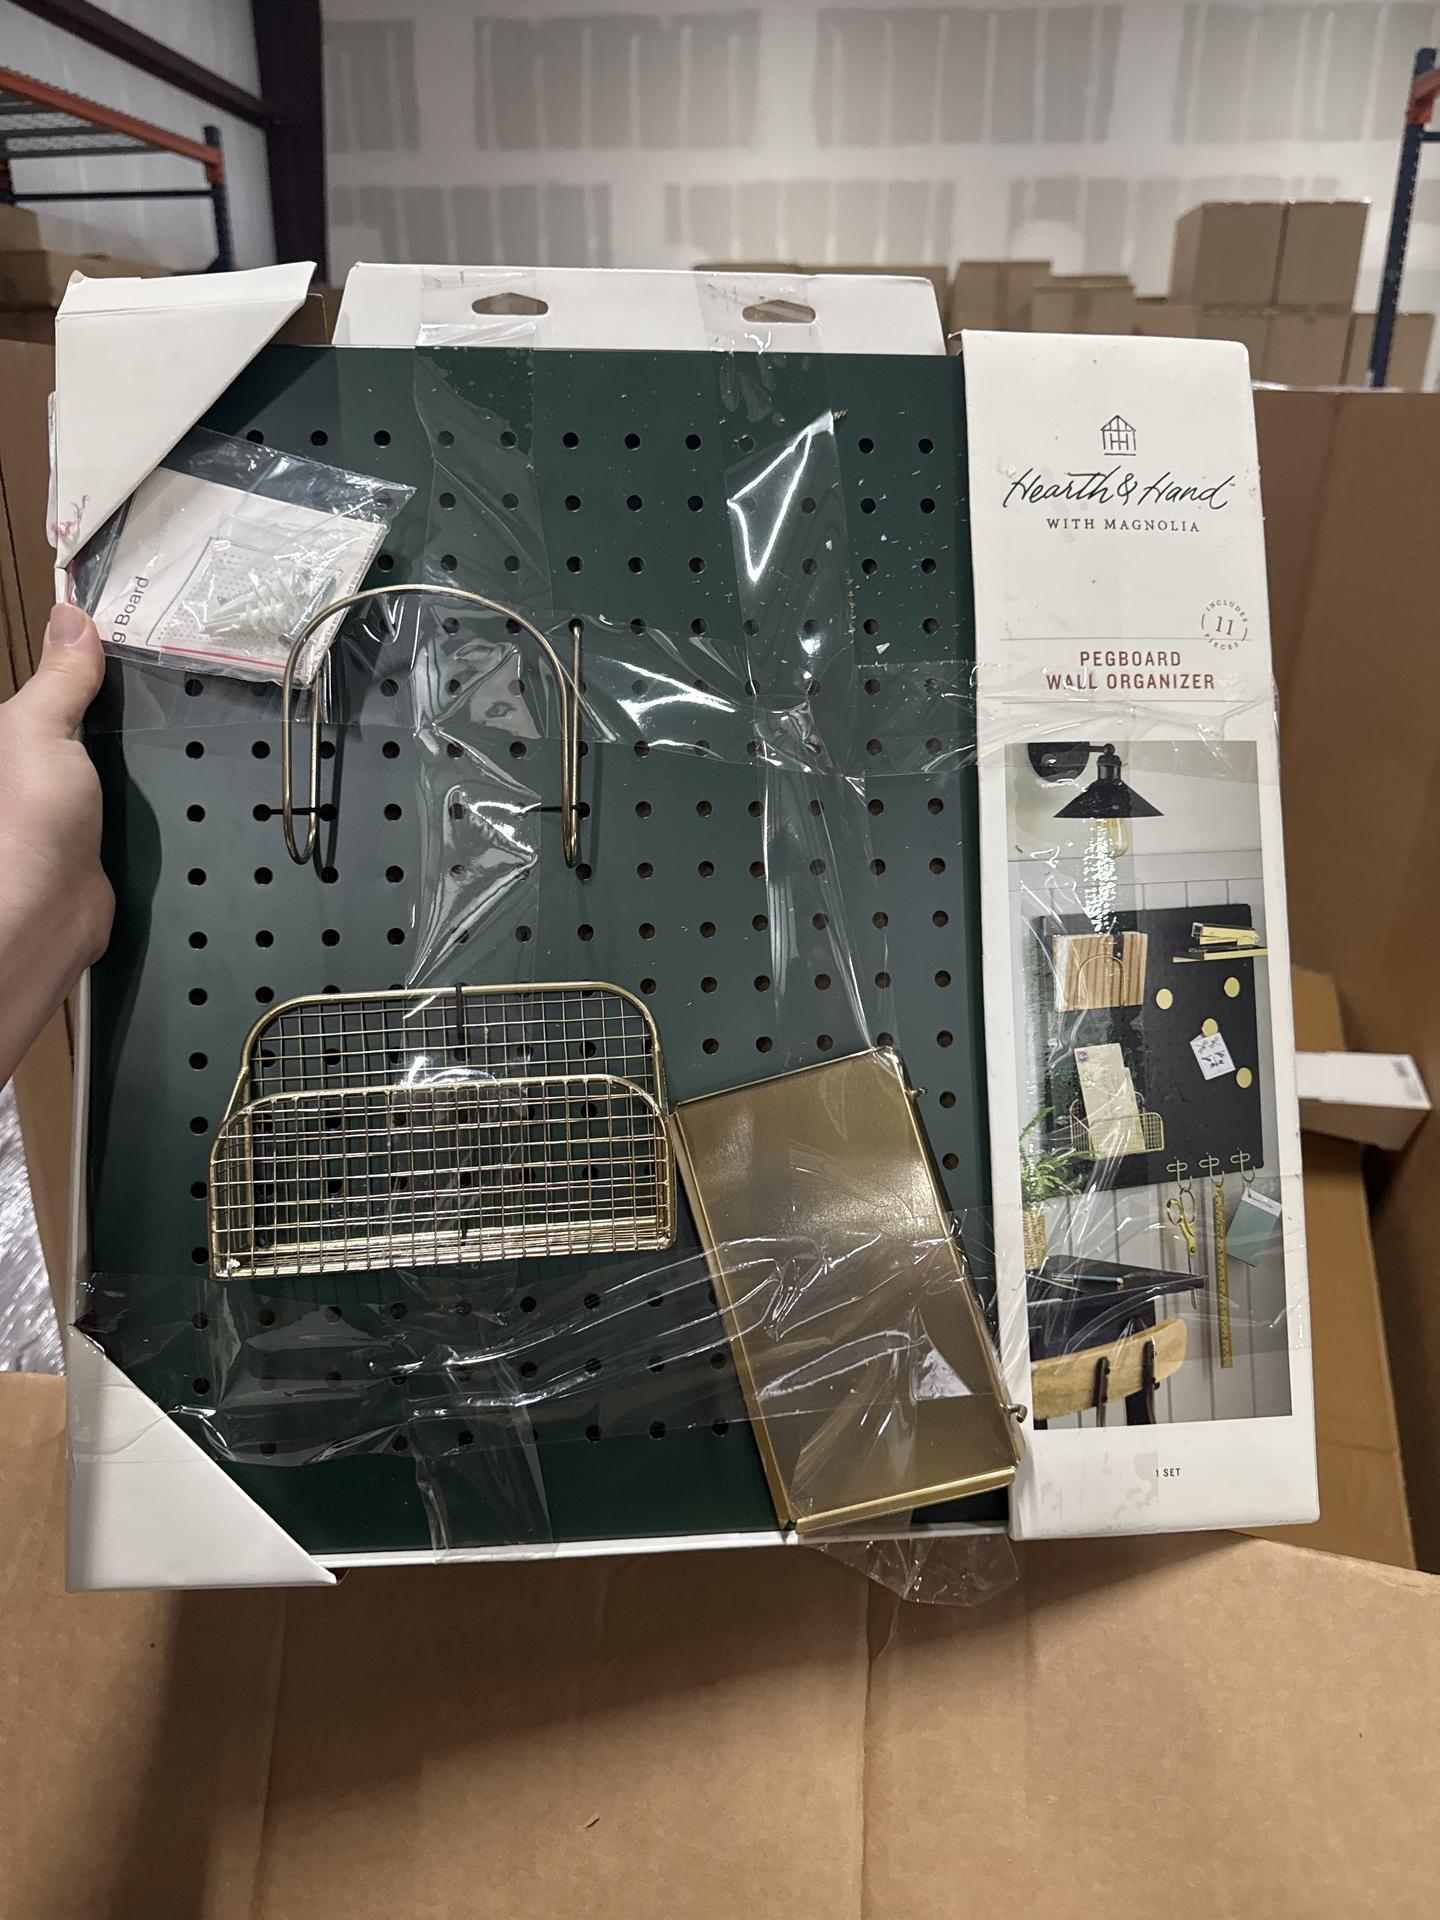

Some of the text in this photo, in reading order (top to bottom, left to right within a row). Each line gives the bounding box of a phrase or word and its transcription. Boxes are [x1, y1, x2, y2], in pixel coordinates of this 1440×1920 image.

[1002, 465, 1121, 508] Hearth
[1117, 472, 1138, 506] &
[1046, 518, 1200, 533] WITH MAGNOLIA
[114, 575, 150, 626] Board
[1205, 599, 1248, 623] INCLUDES
[1215, 615, 1233, 636] 11
[1079, 650, 1182, 667] PEGBOARD
[1046, 673, 1216, 690] WALL ORGANIZER
[1163, 1467, 1181, 1478] SET
